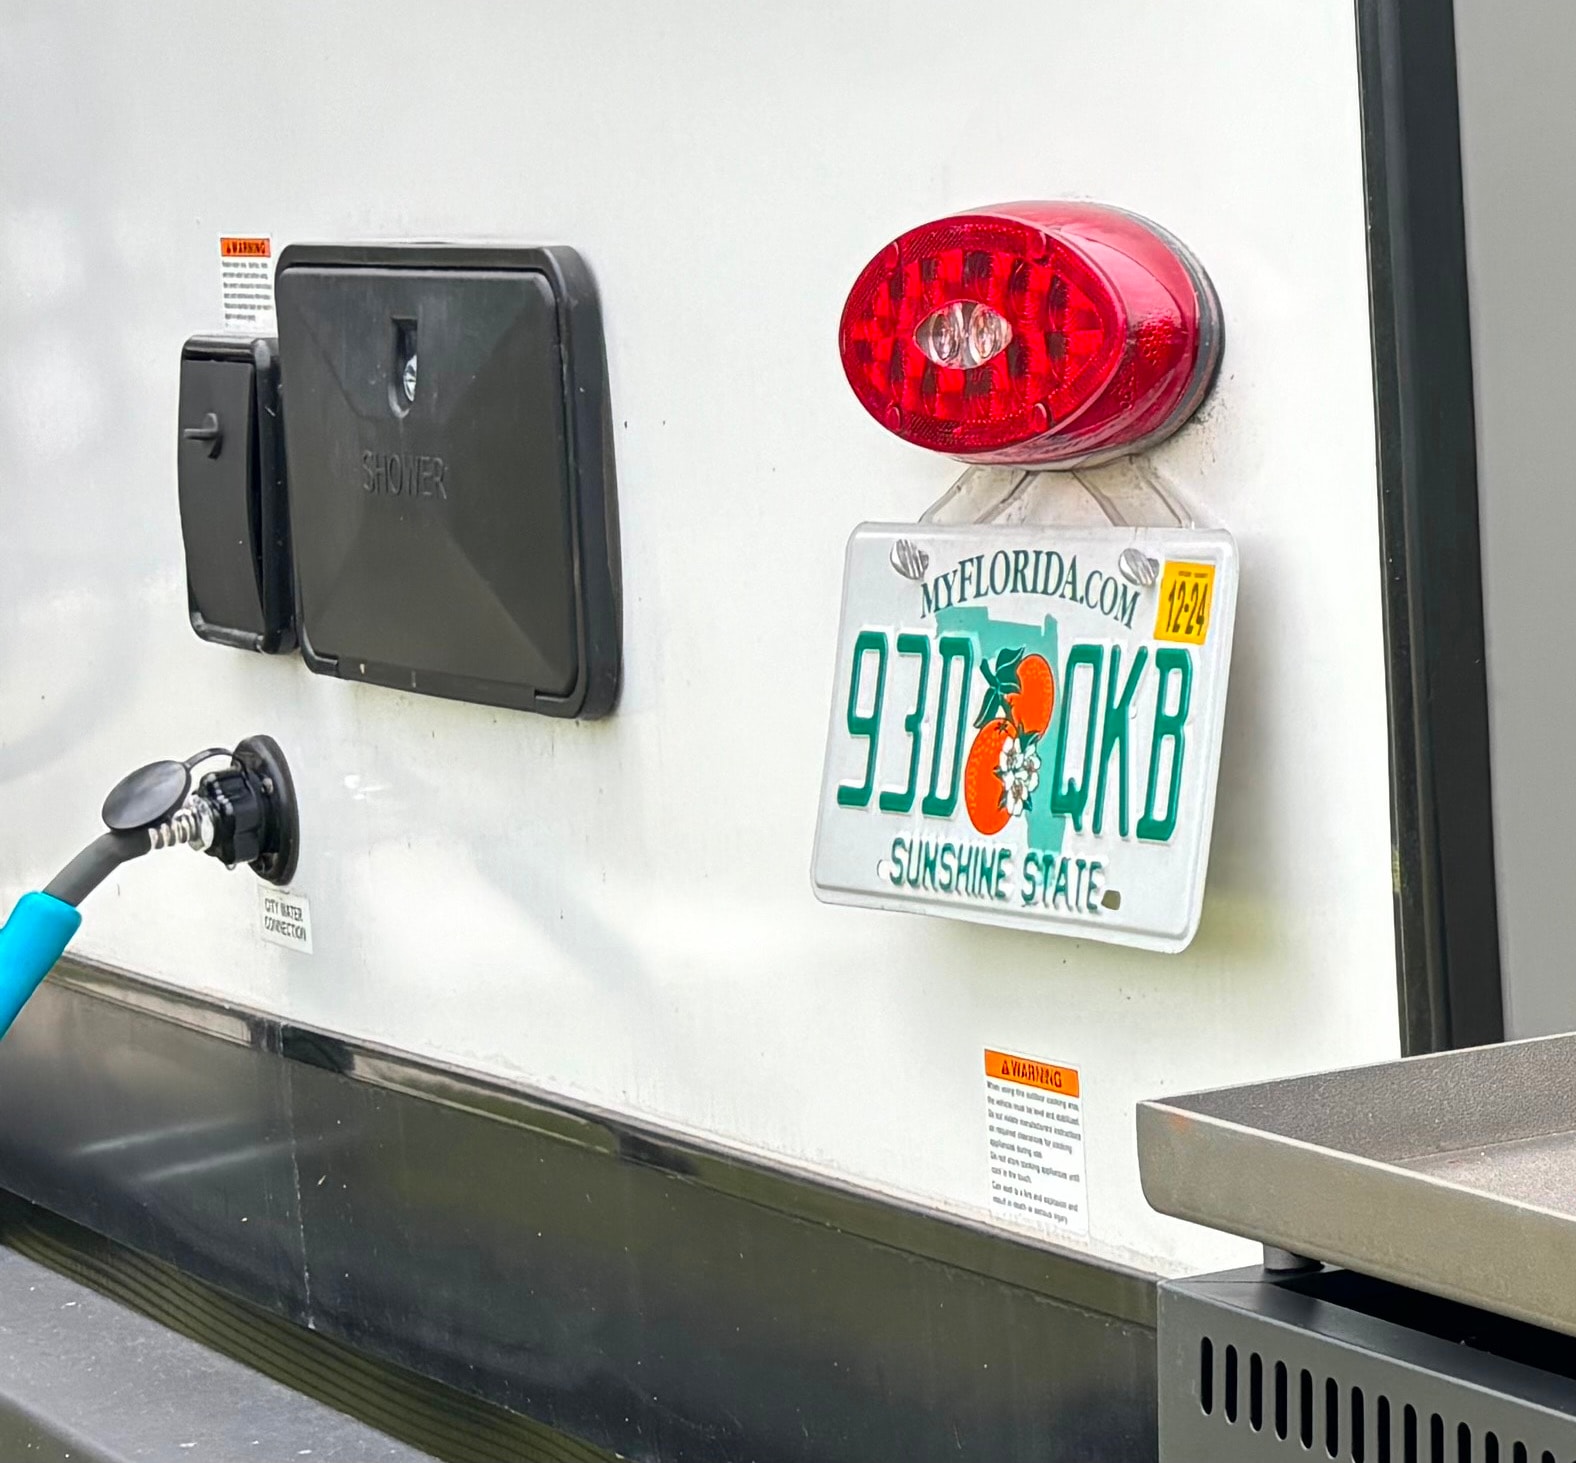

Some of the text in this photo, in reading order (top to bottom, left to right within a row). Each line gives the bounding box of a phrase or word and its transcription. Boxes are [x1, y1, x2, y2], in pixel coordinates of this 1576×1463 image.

[362, 449, 448, 500] SHOWER
[920, 549, 1141, 630] MYFLORIDA.COM
[837, 630, 1193, 842] 93D QKB
[889, 837, 1104, 913] SUNSHINE STATE
[1011, 1059, 1063, 1088] WARNING
